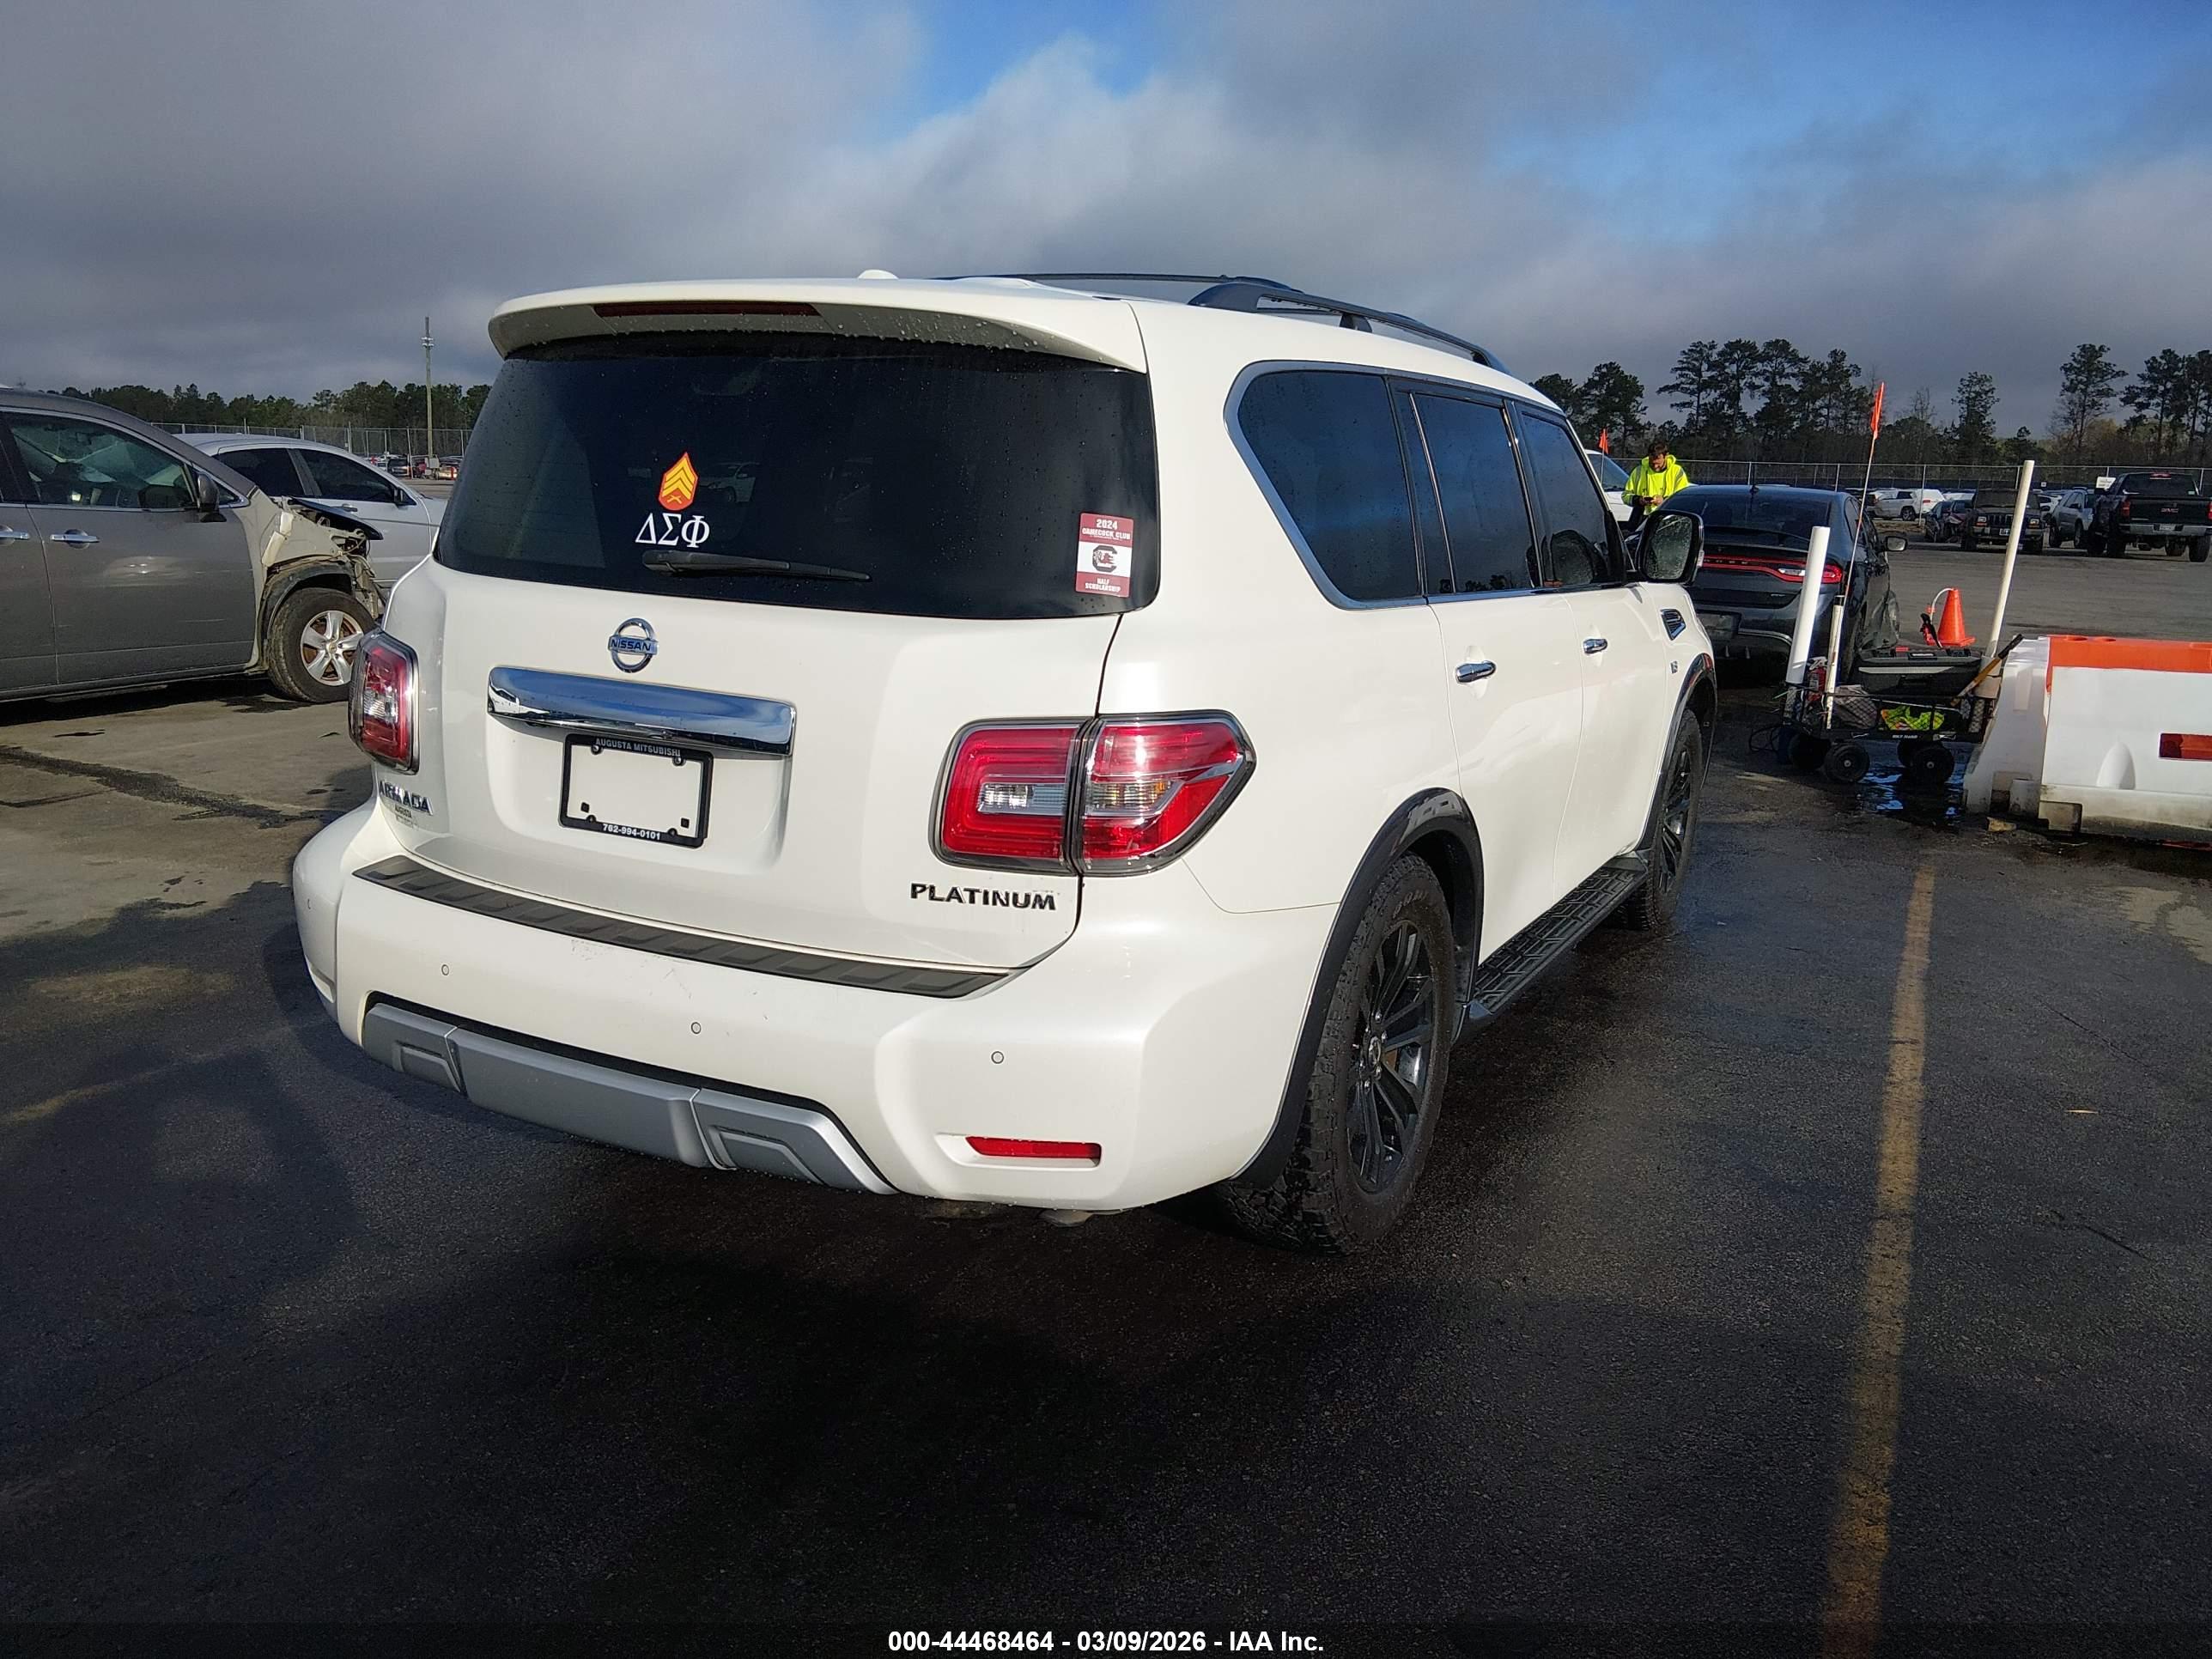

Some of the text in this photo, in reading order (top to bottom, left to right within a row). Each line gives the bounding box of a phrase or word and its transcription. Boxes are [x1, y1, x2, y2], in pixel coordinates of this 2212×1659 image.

[635, 513, 710, 548] ΔΣΦ
[1096, 519, 1118, 530] 2024
[1115, 532, 1131, 540] CLUB
[611, 639, 651, 651] NISSAN
[596, 738, 681, 757] AUGUSTA MITSUBISHI
[603, 823, 660, 840] 762-994-0101
[910, 883, 1055, 910] PLATINUM
